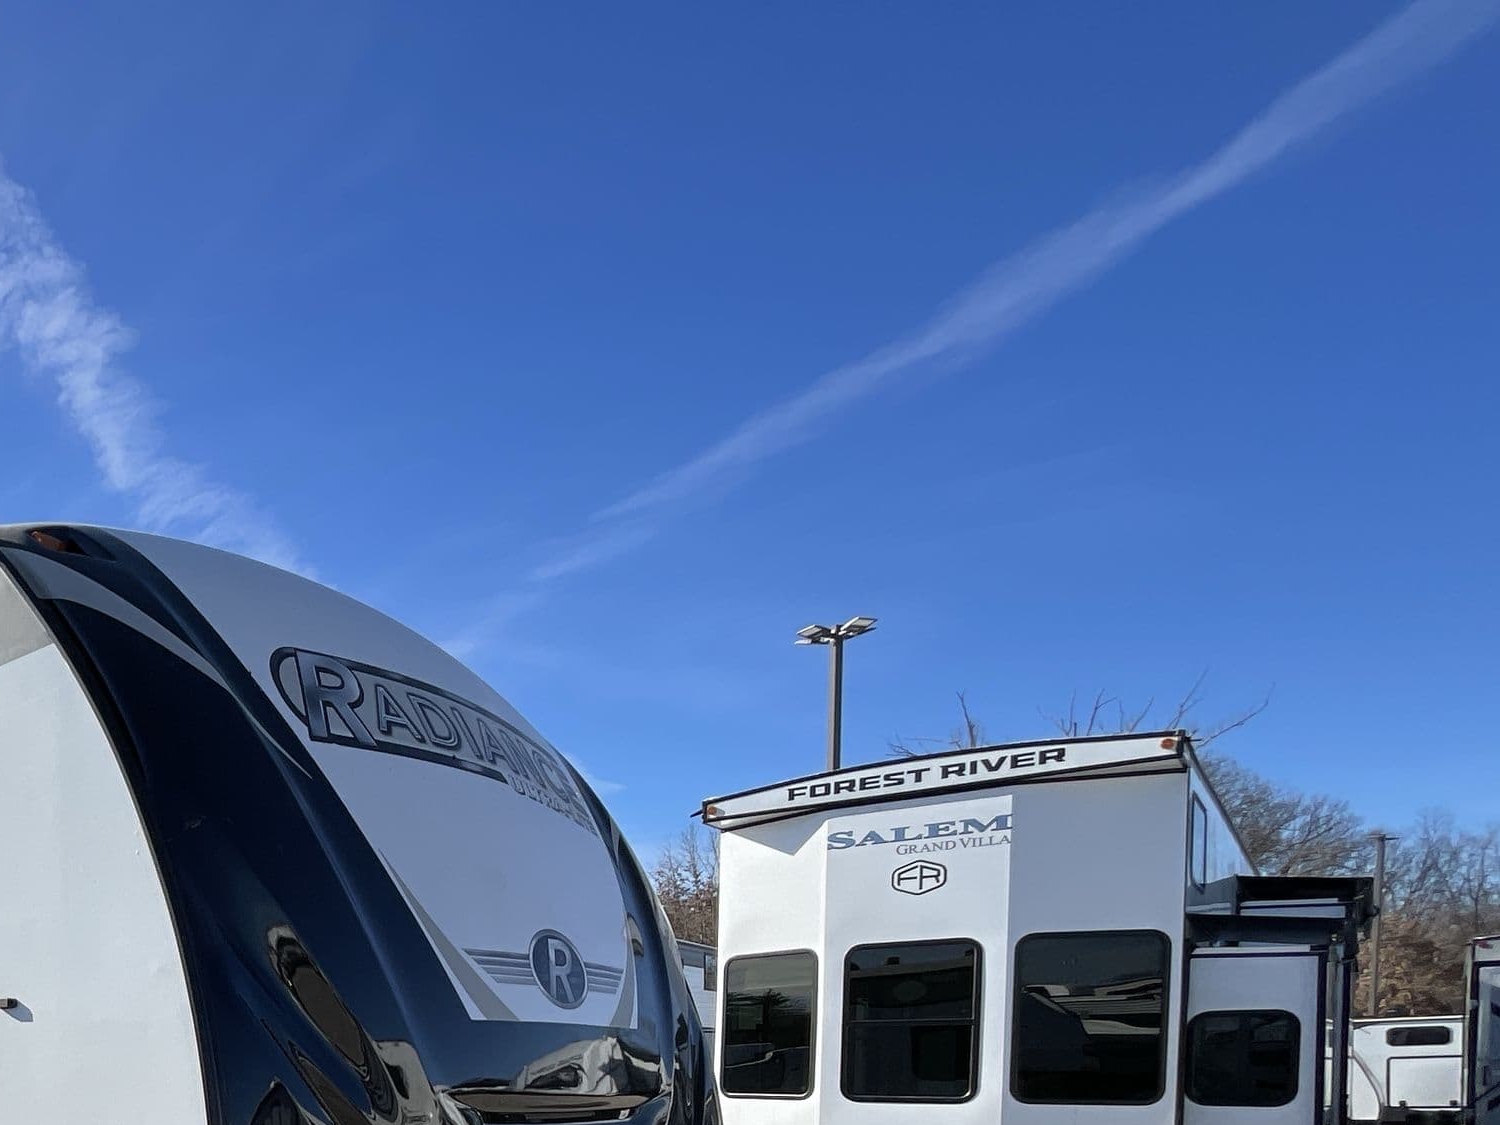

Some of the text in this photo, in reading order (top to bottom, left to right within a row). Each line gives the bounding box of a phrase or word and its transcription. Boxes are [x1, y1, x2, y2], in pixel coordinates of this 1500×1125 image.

[294, 648, 590, 820] RADIANCE
[787, 747, 1067, 802] FOREST RIVER
[827, 813, 1013, 851] SALEM
[895, 833, 1012, 856] GRAND VILLA
[548, 937, 575, 1000] R
